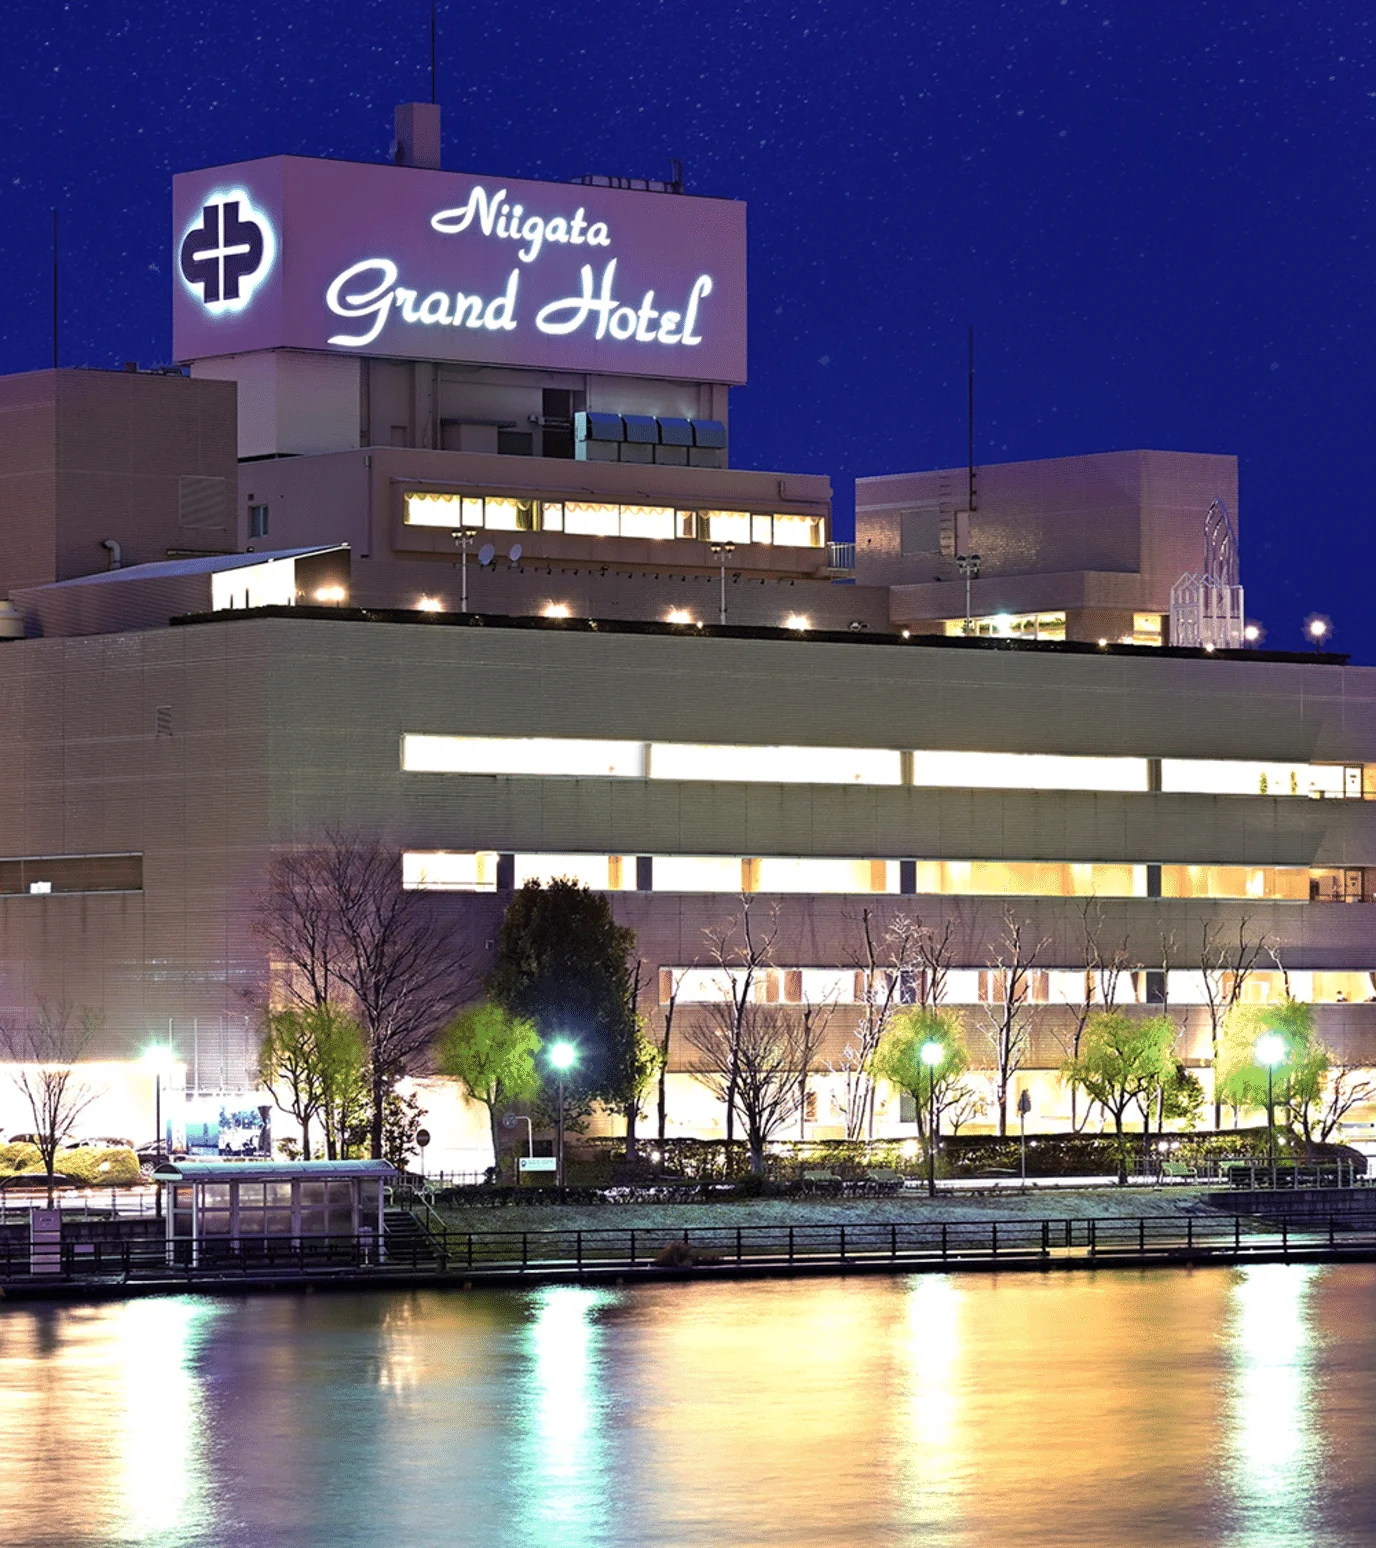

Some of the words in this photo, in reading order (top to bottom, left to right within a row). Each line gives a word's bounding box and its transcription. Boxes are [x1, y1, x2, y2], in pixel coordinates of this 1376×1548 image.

[430, 185, 612, 263] Niigata
[326, 257, 519, 347] Grand
[535, 257, 713, 347] Hotel
